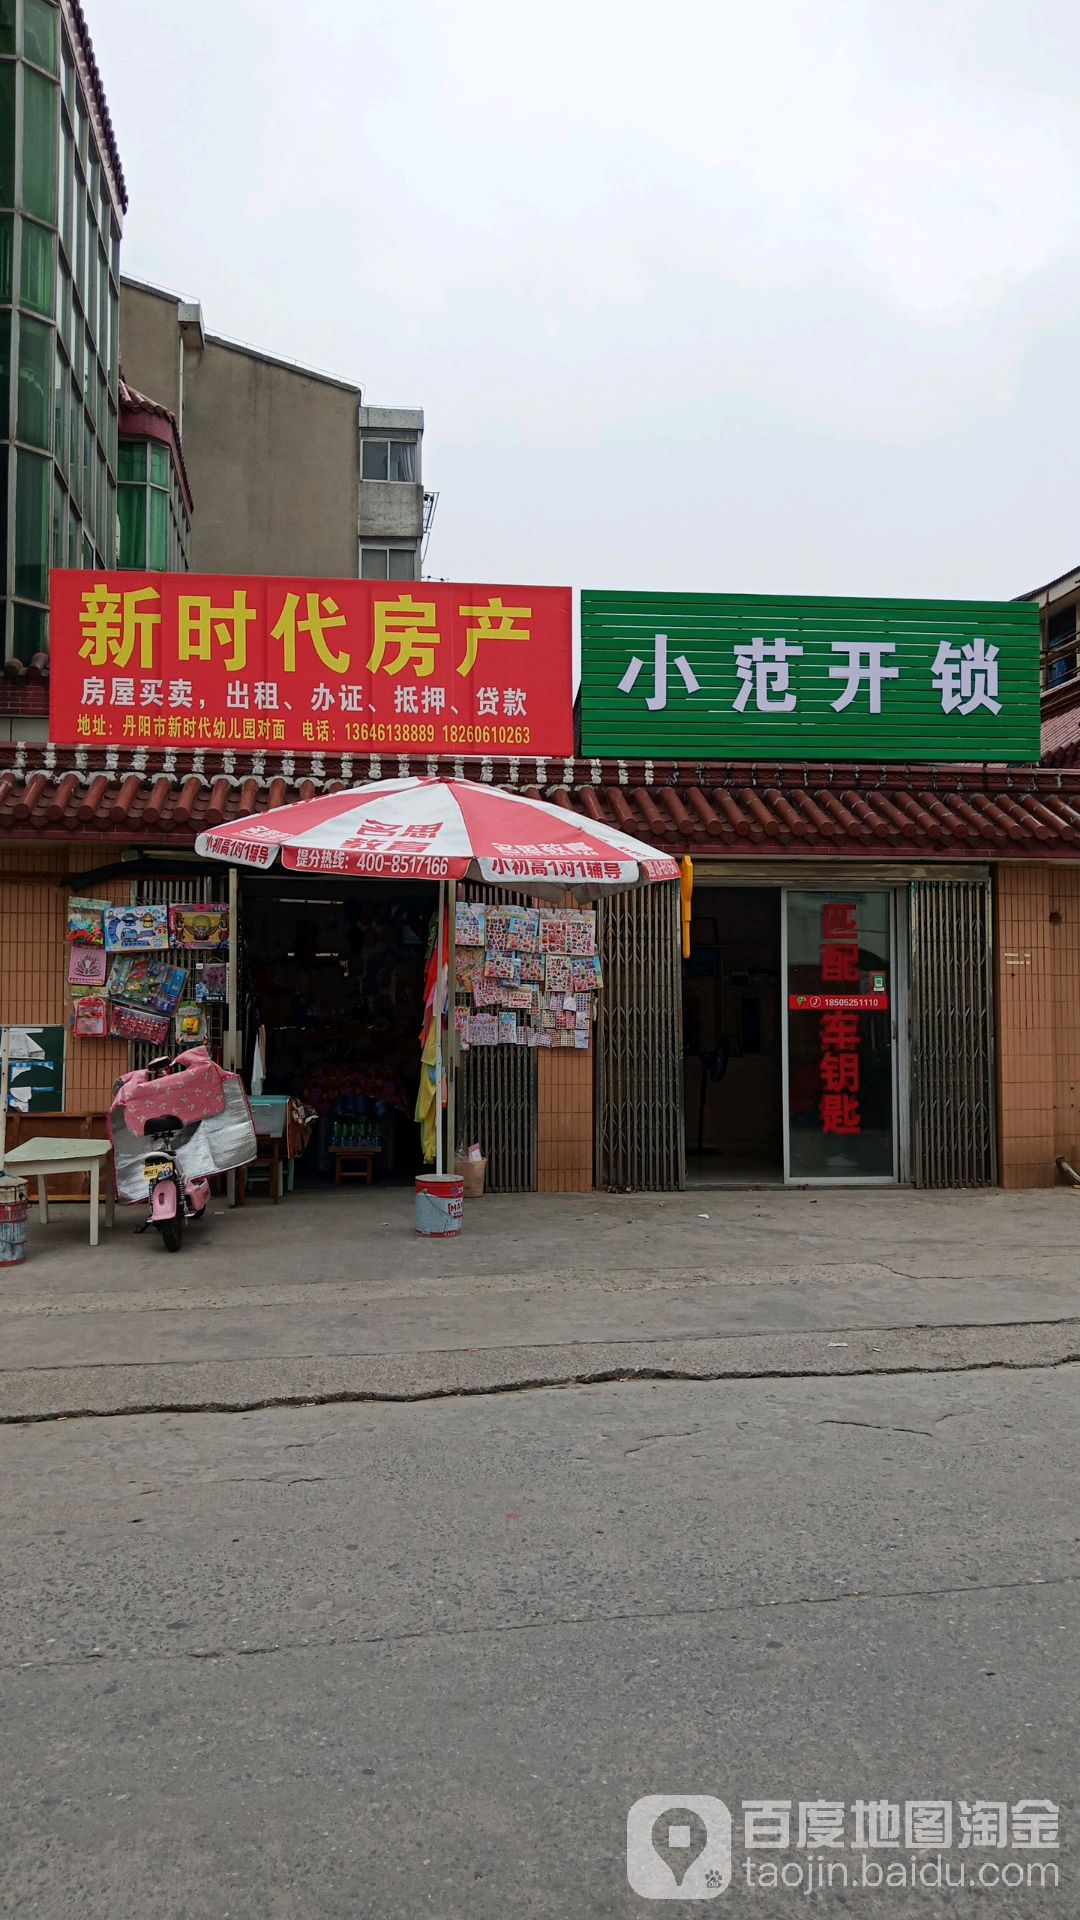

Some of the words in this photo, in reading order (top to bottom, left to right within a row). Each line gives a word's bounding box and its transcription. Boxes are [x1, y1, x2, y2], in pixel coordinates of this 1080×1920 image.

[78, 584, 532, 677] 新时代房产
[617, 634, 1003, 716] 小范开锁
[442, 724, 531, 744] 18260610263
[825, 998, 879, 1007] 18505251110
